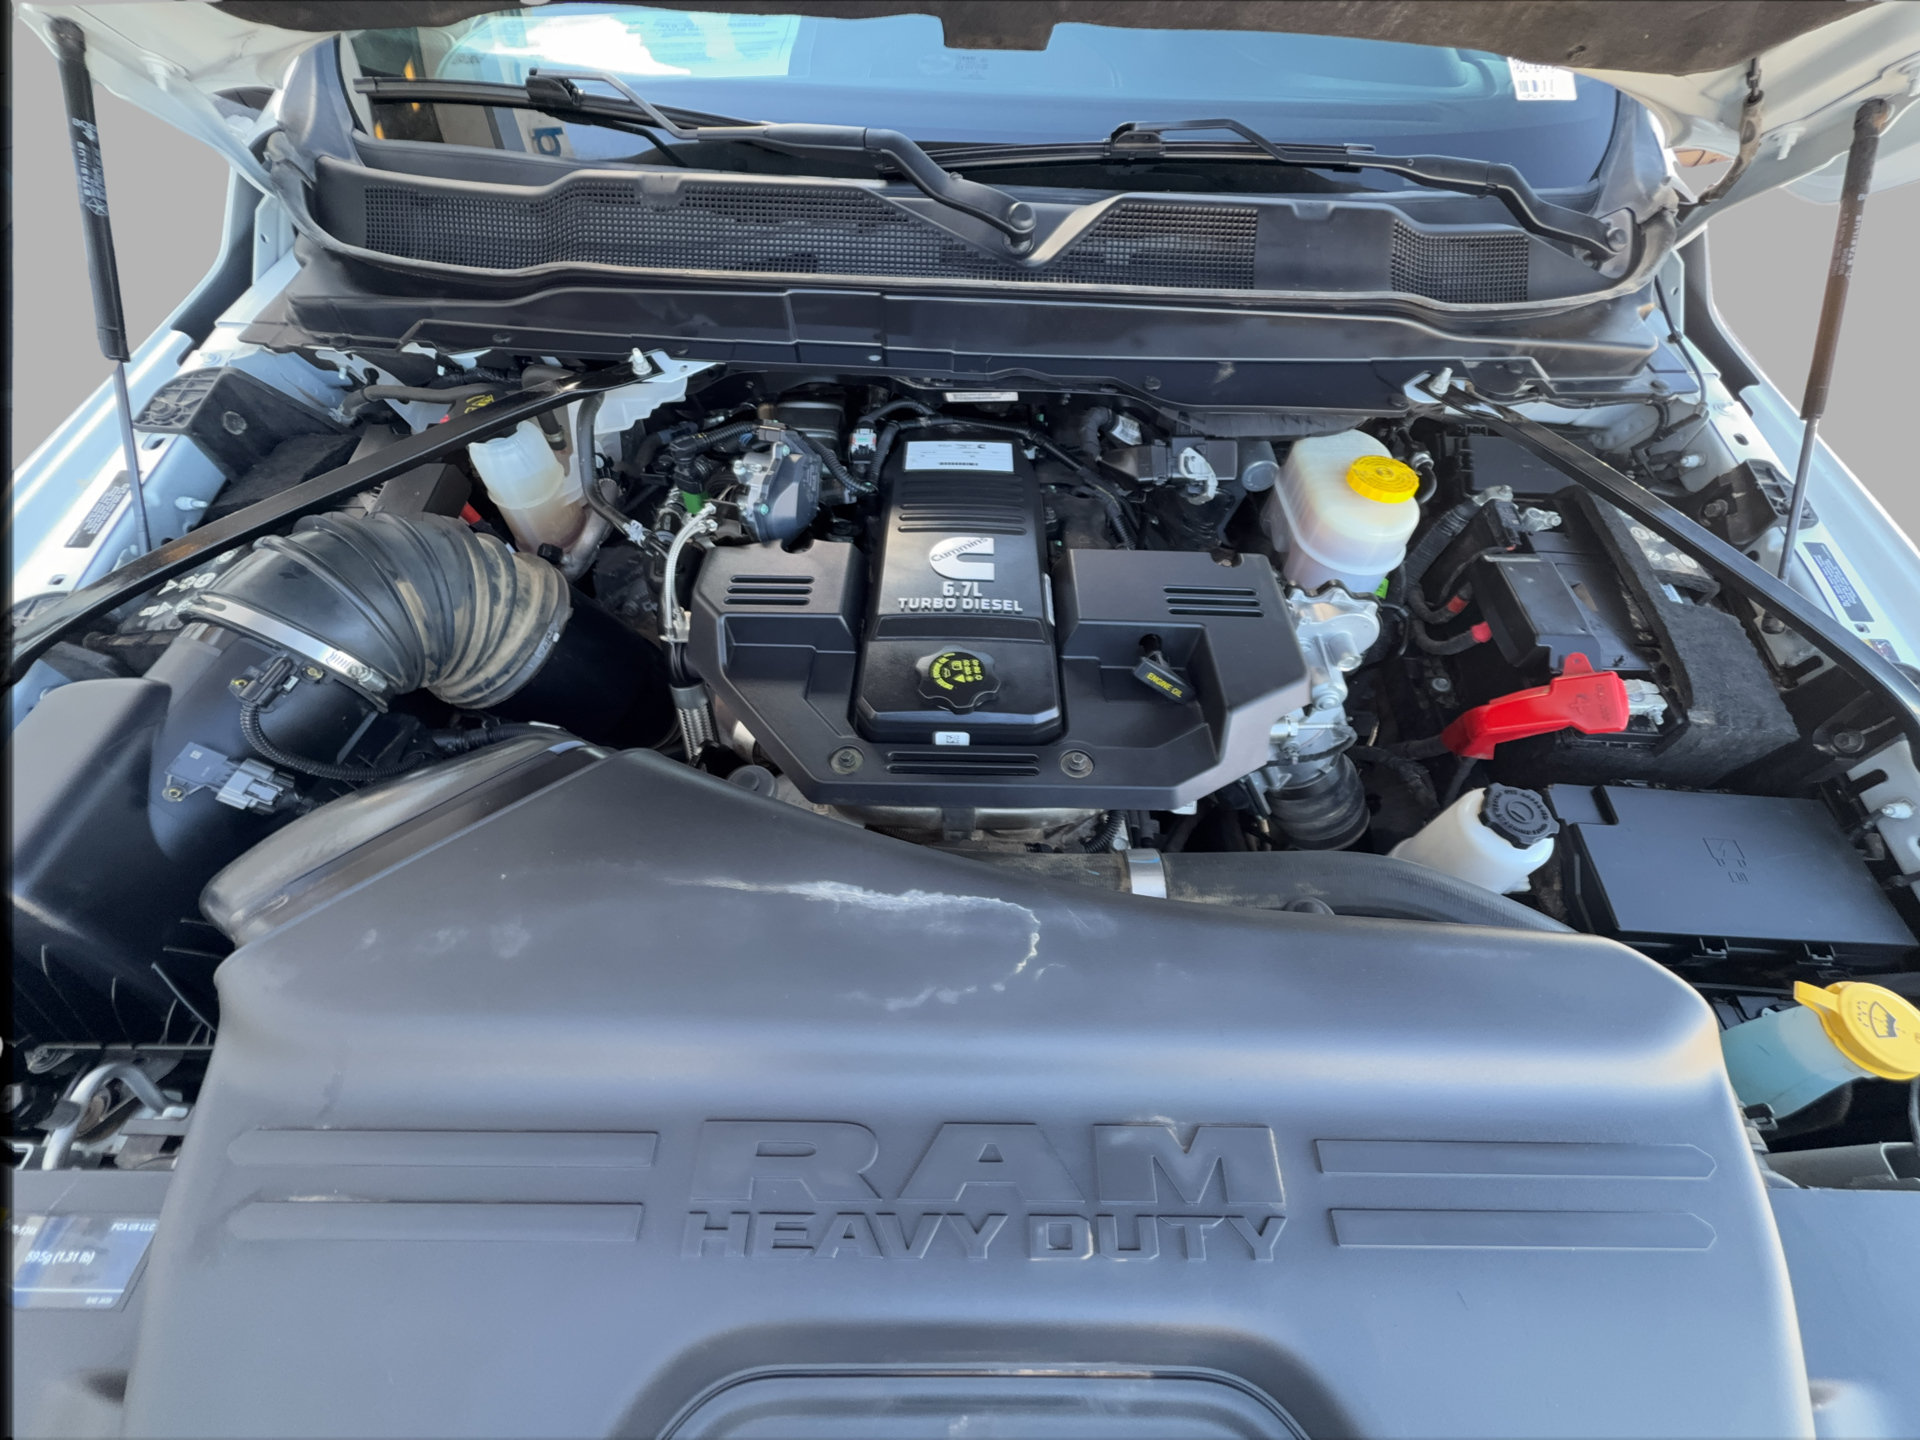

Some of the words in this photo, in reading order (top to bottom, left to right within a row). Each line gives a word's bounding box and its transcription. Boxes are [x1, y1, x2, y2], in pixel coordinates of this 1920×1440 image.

[930, 537, 989, 563] Cummins
[943, 581, 983, 597] 6.7L
[898, 597, 957, 612] TURBO
[962, 599, 1024, 614] DIESEL
[1145, 672, 1174, 692] ENGINE
[1170, 686, 1183, 698] OIL
[692, 1118, 1287, 1207] RAM
[110, 1222, 128, 1232] FCA
[139, 1223, 156, 1232] LLC
[684, 1209, 1009, 1260] HEAVY
[1028, 1211, 1288, 1262] DUTY
[79, 1250, 96, 1266] lb)
